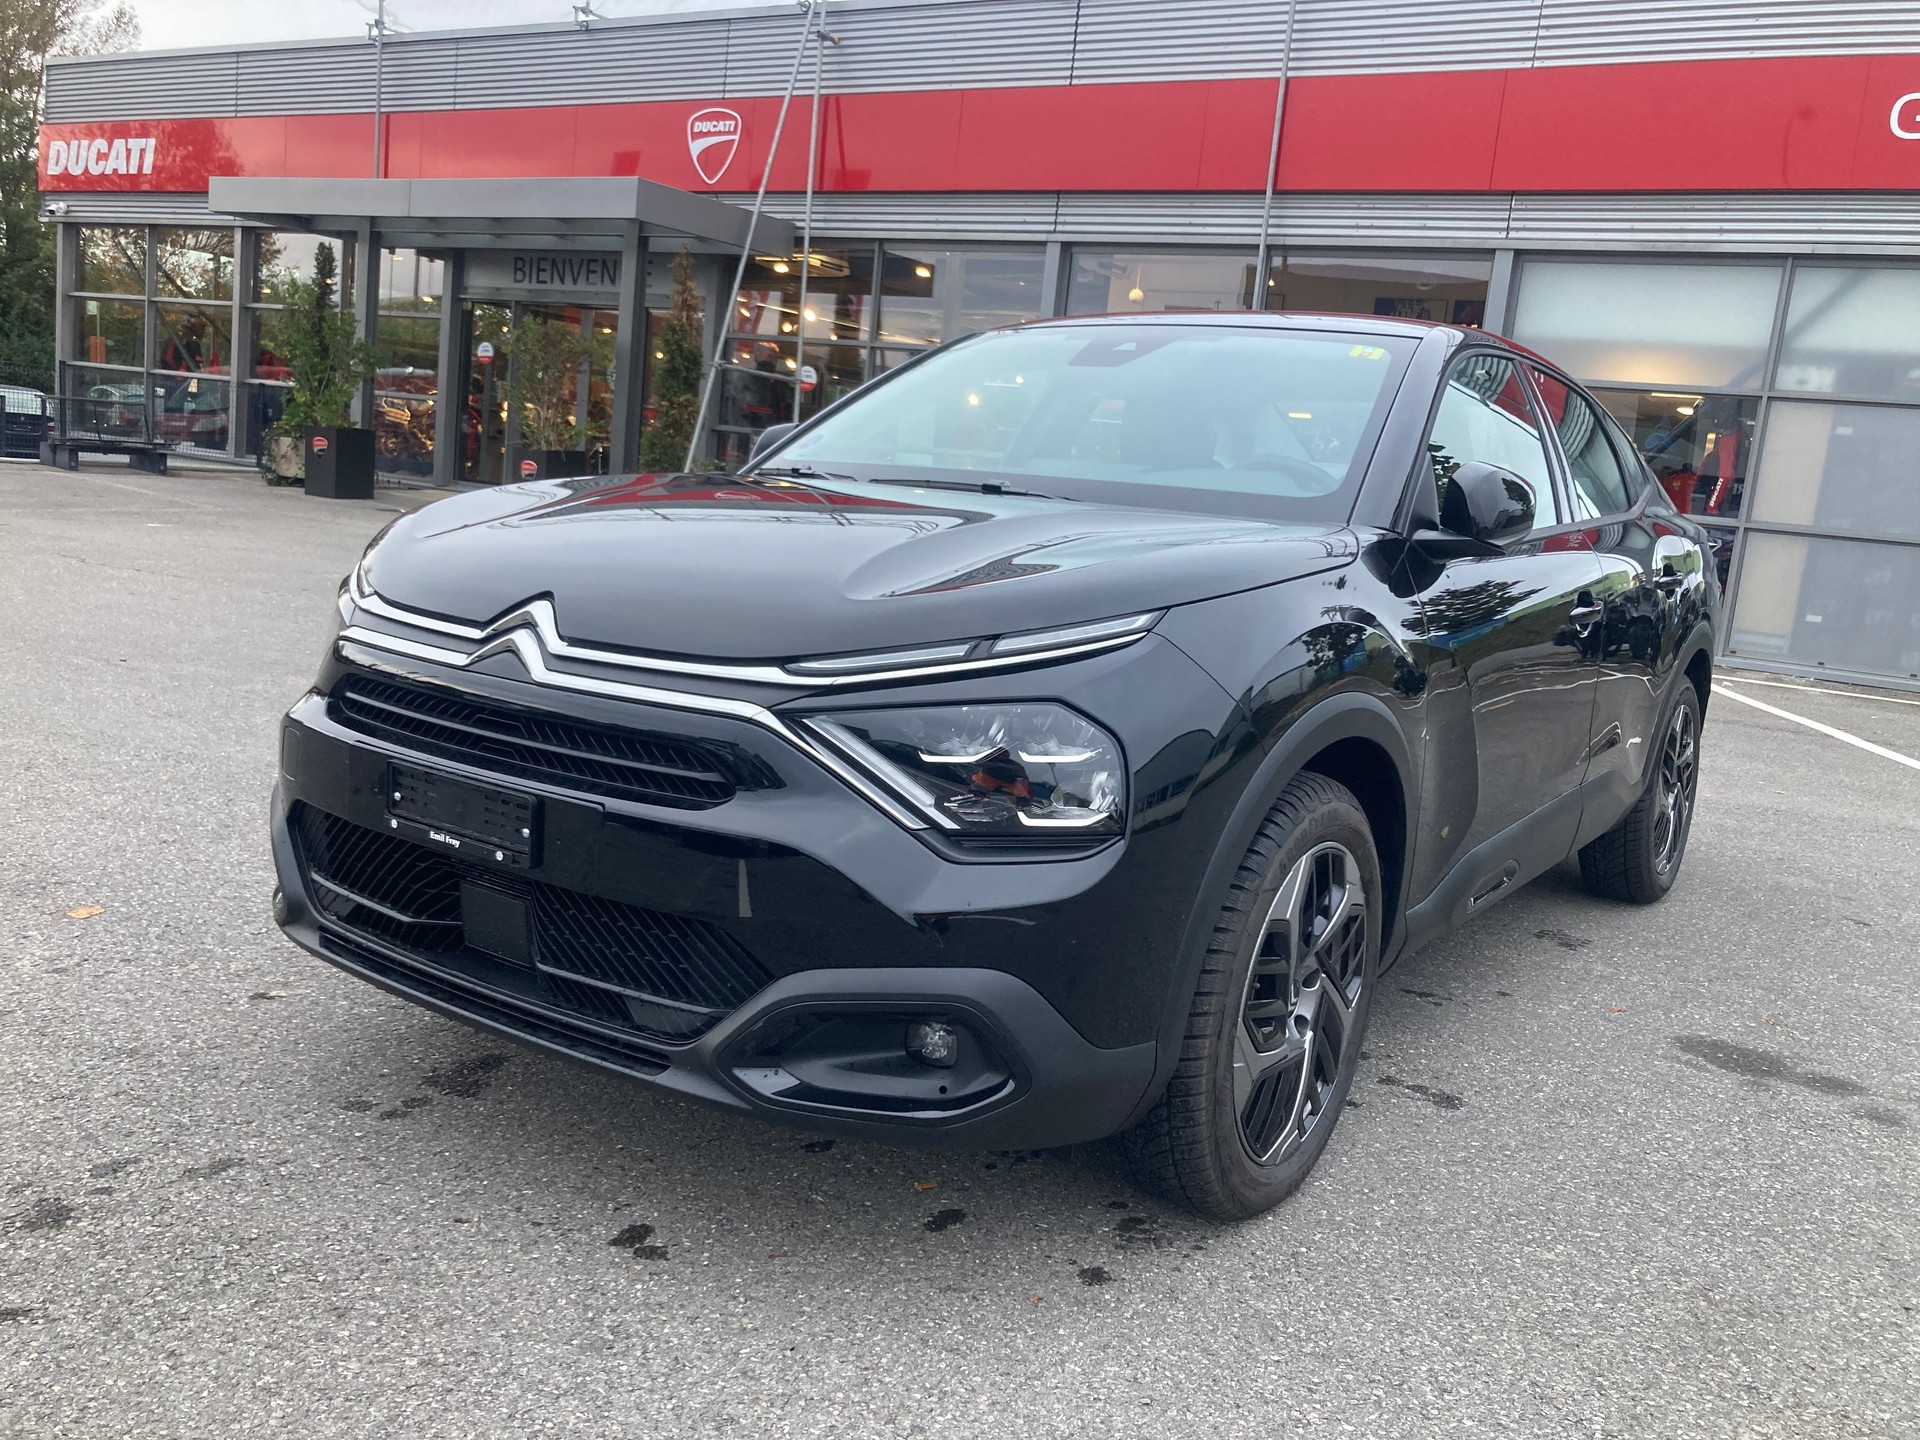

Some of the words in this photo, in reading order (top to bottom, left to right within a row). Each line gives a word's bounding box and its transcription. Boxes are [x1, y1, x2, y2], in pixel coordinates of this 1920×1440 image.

[694, 121, 736, 132] DUCATI
[46, 138, 156, 175] DUCATI
[513, 256, 653, 288] BIENVEN
[430, 831, 445, 842] Emil
[445, 835, 460, 848] Frey
